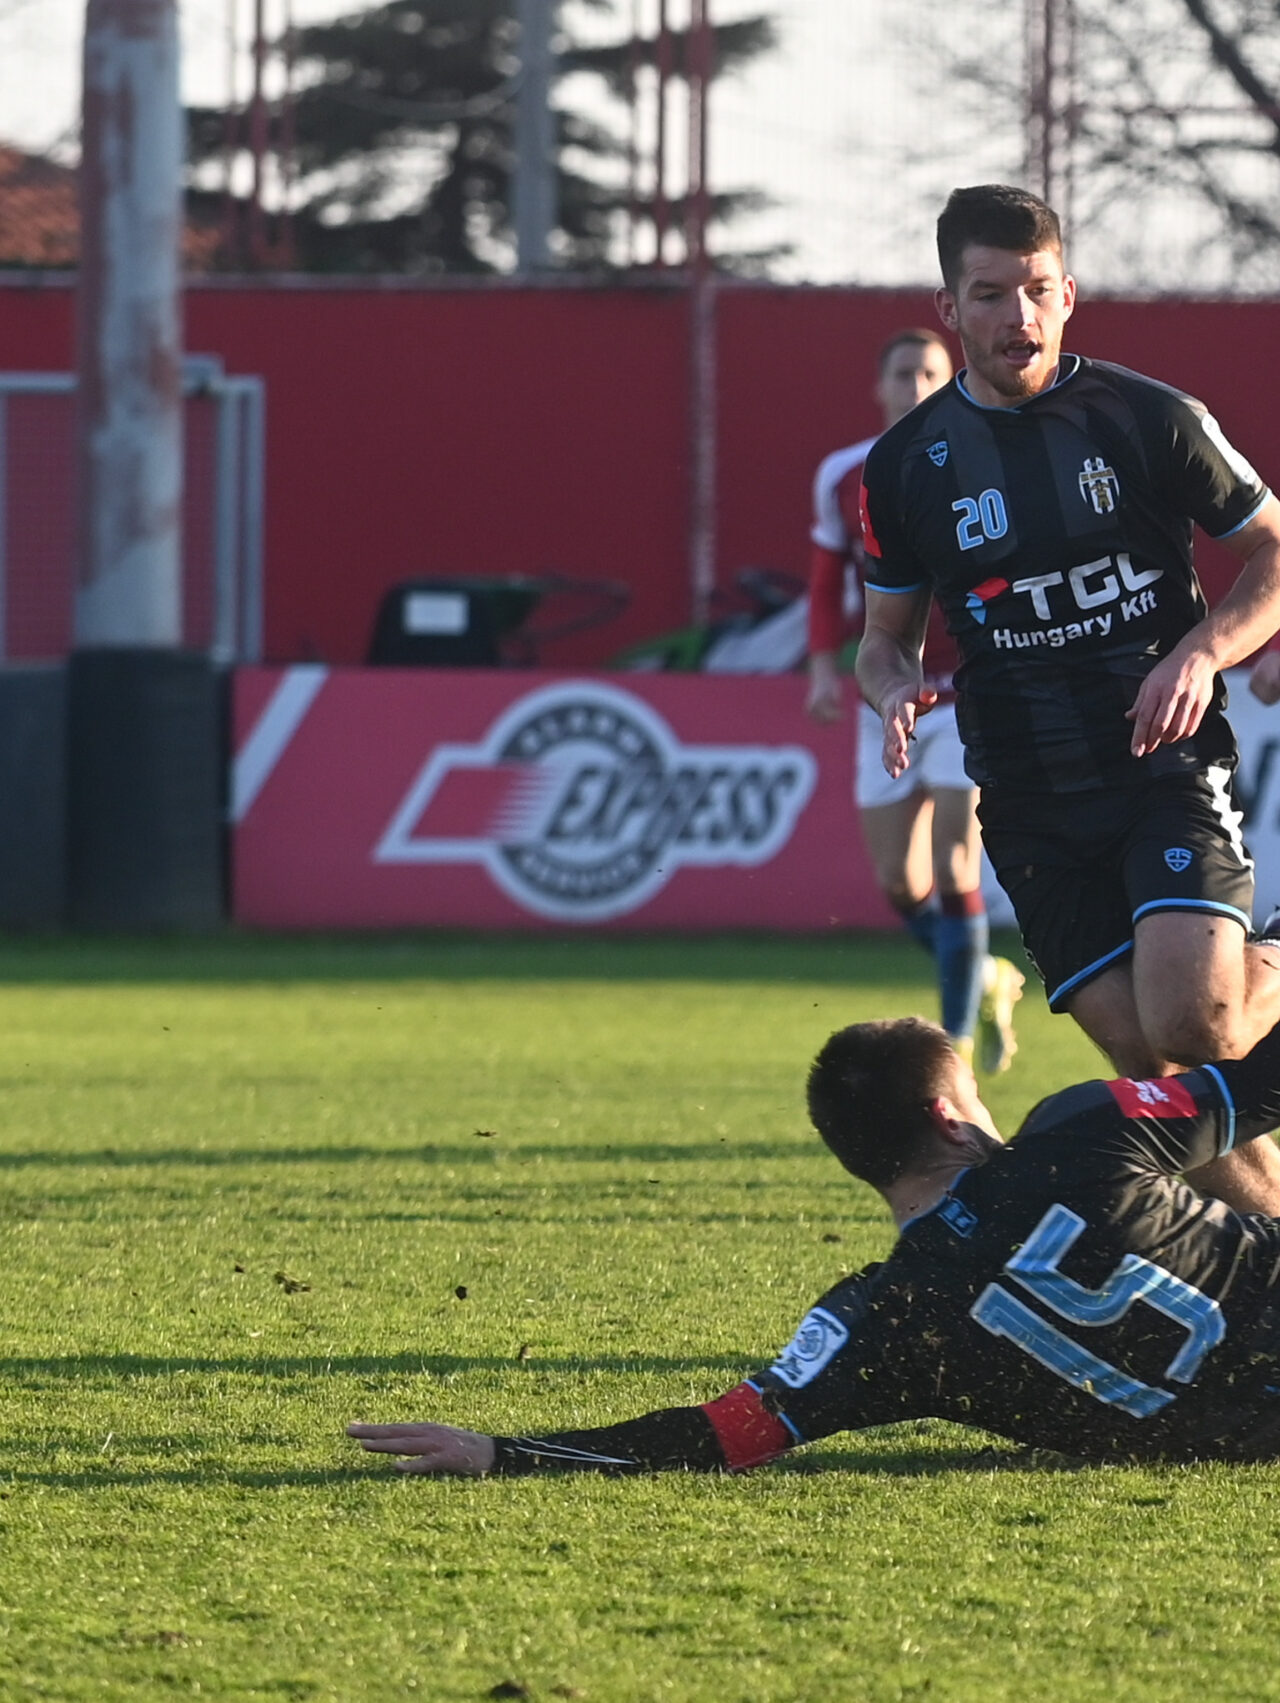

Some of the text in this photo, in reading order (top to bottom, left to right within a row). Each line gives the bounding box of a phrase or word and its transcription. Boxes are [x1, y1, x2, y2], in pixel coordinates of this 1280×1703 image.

[952, 488, 1009, 551] 20
[992, 589, 1158, 649] Hungary Kft
[1013, 552, 1164, 621] TGL
[545, 765, 799, 847] EXPRESS
[971, 1203, 1227, 1419] 15
